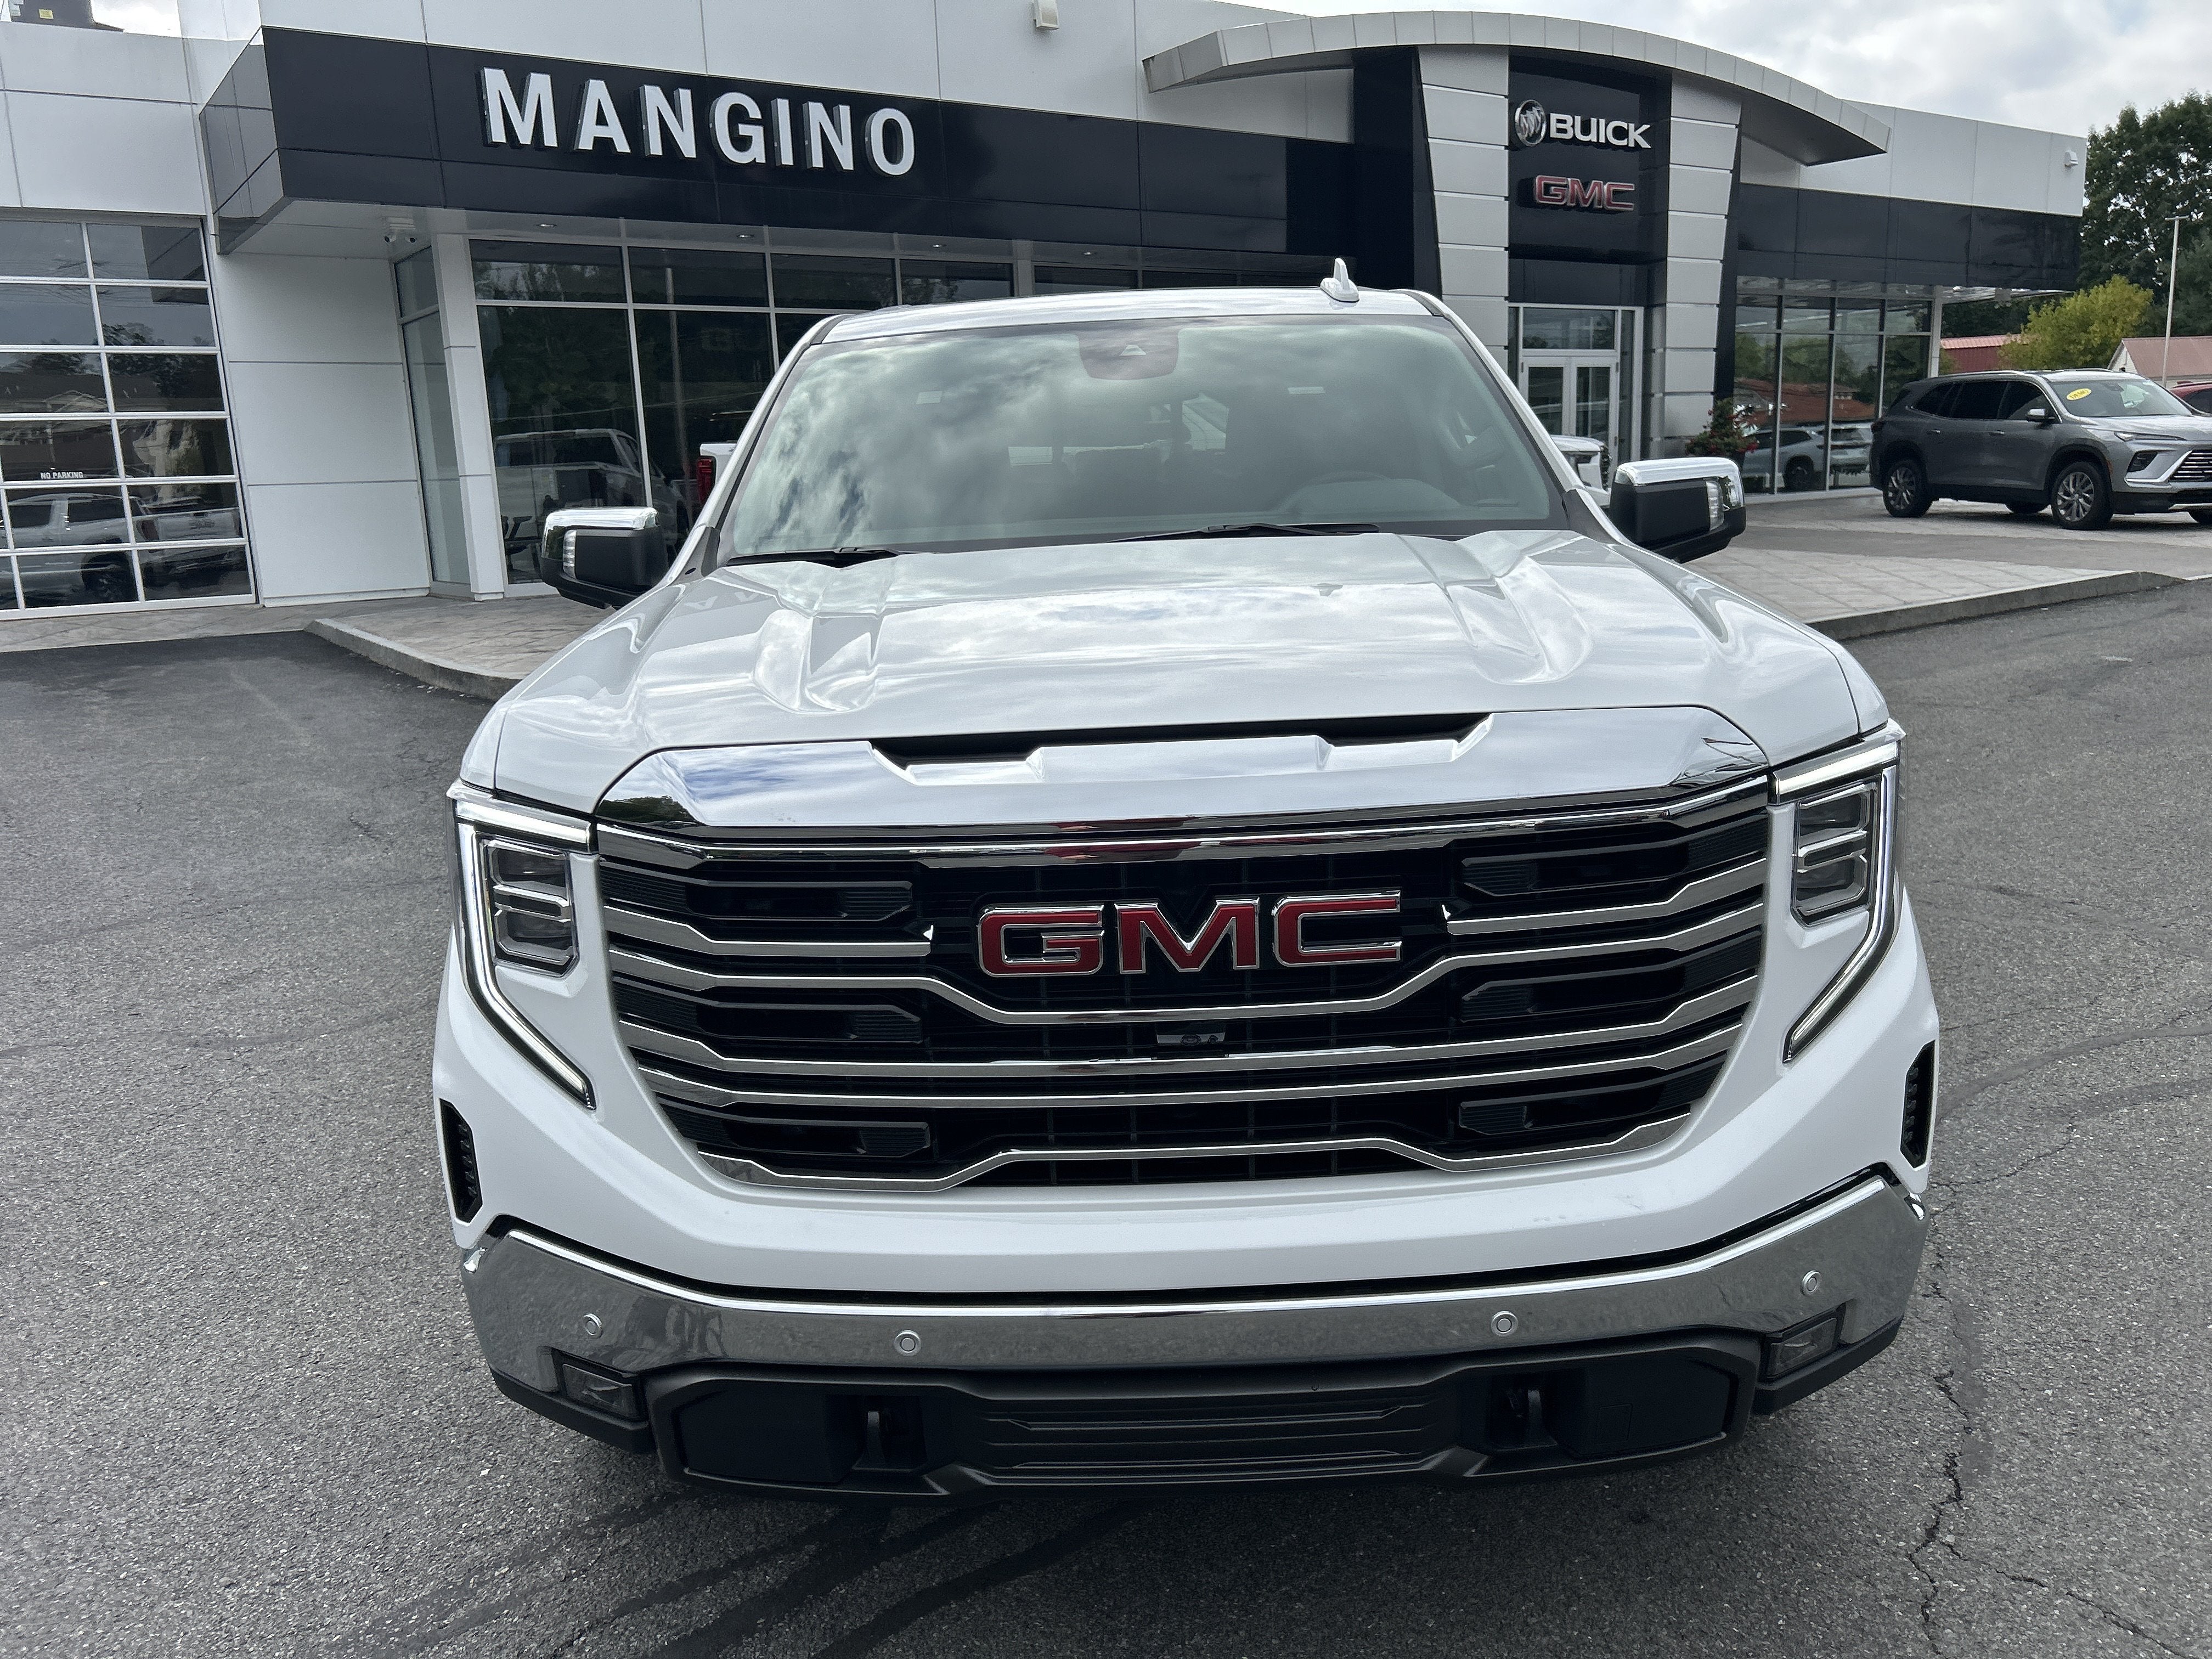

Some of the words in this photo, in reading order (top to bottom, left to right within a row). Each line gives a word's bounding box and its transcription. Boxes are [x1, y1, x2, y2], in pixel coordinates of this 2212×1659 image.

[480, 67, 915, 176] MANGINO
[1550, 113, 1651, 148] BUICK
[1535, 174, 1635, 211] GMC
[978, 889, 1402, 977] GMC
